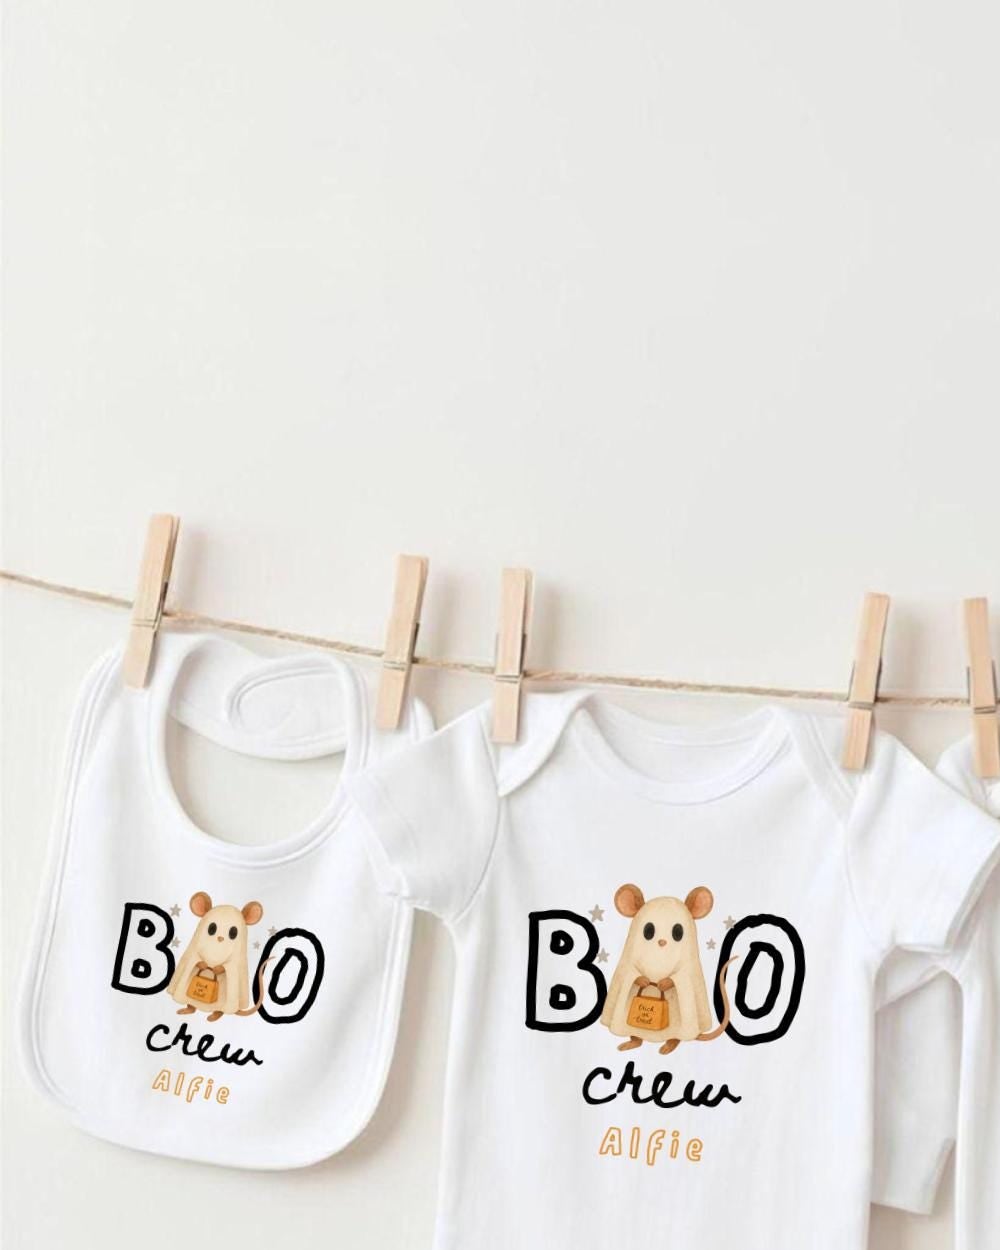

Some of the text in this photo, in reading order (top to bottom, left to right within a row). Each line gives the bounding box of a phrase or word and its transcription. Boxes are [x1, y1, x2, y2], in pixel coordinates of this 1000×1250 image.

[145, 1022, 264, 1066] crew
[151, 1069, 230, 1105] Alfie
[582, 1060, 742, 1109] crew
[598, 1126, 704, 1167] Alfie
